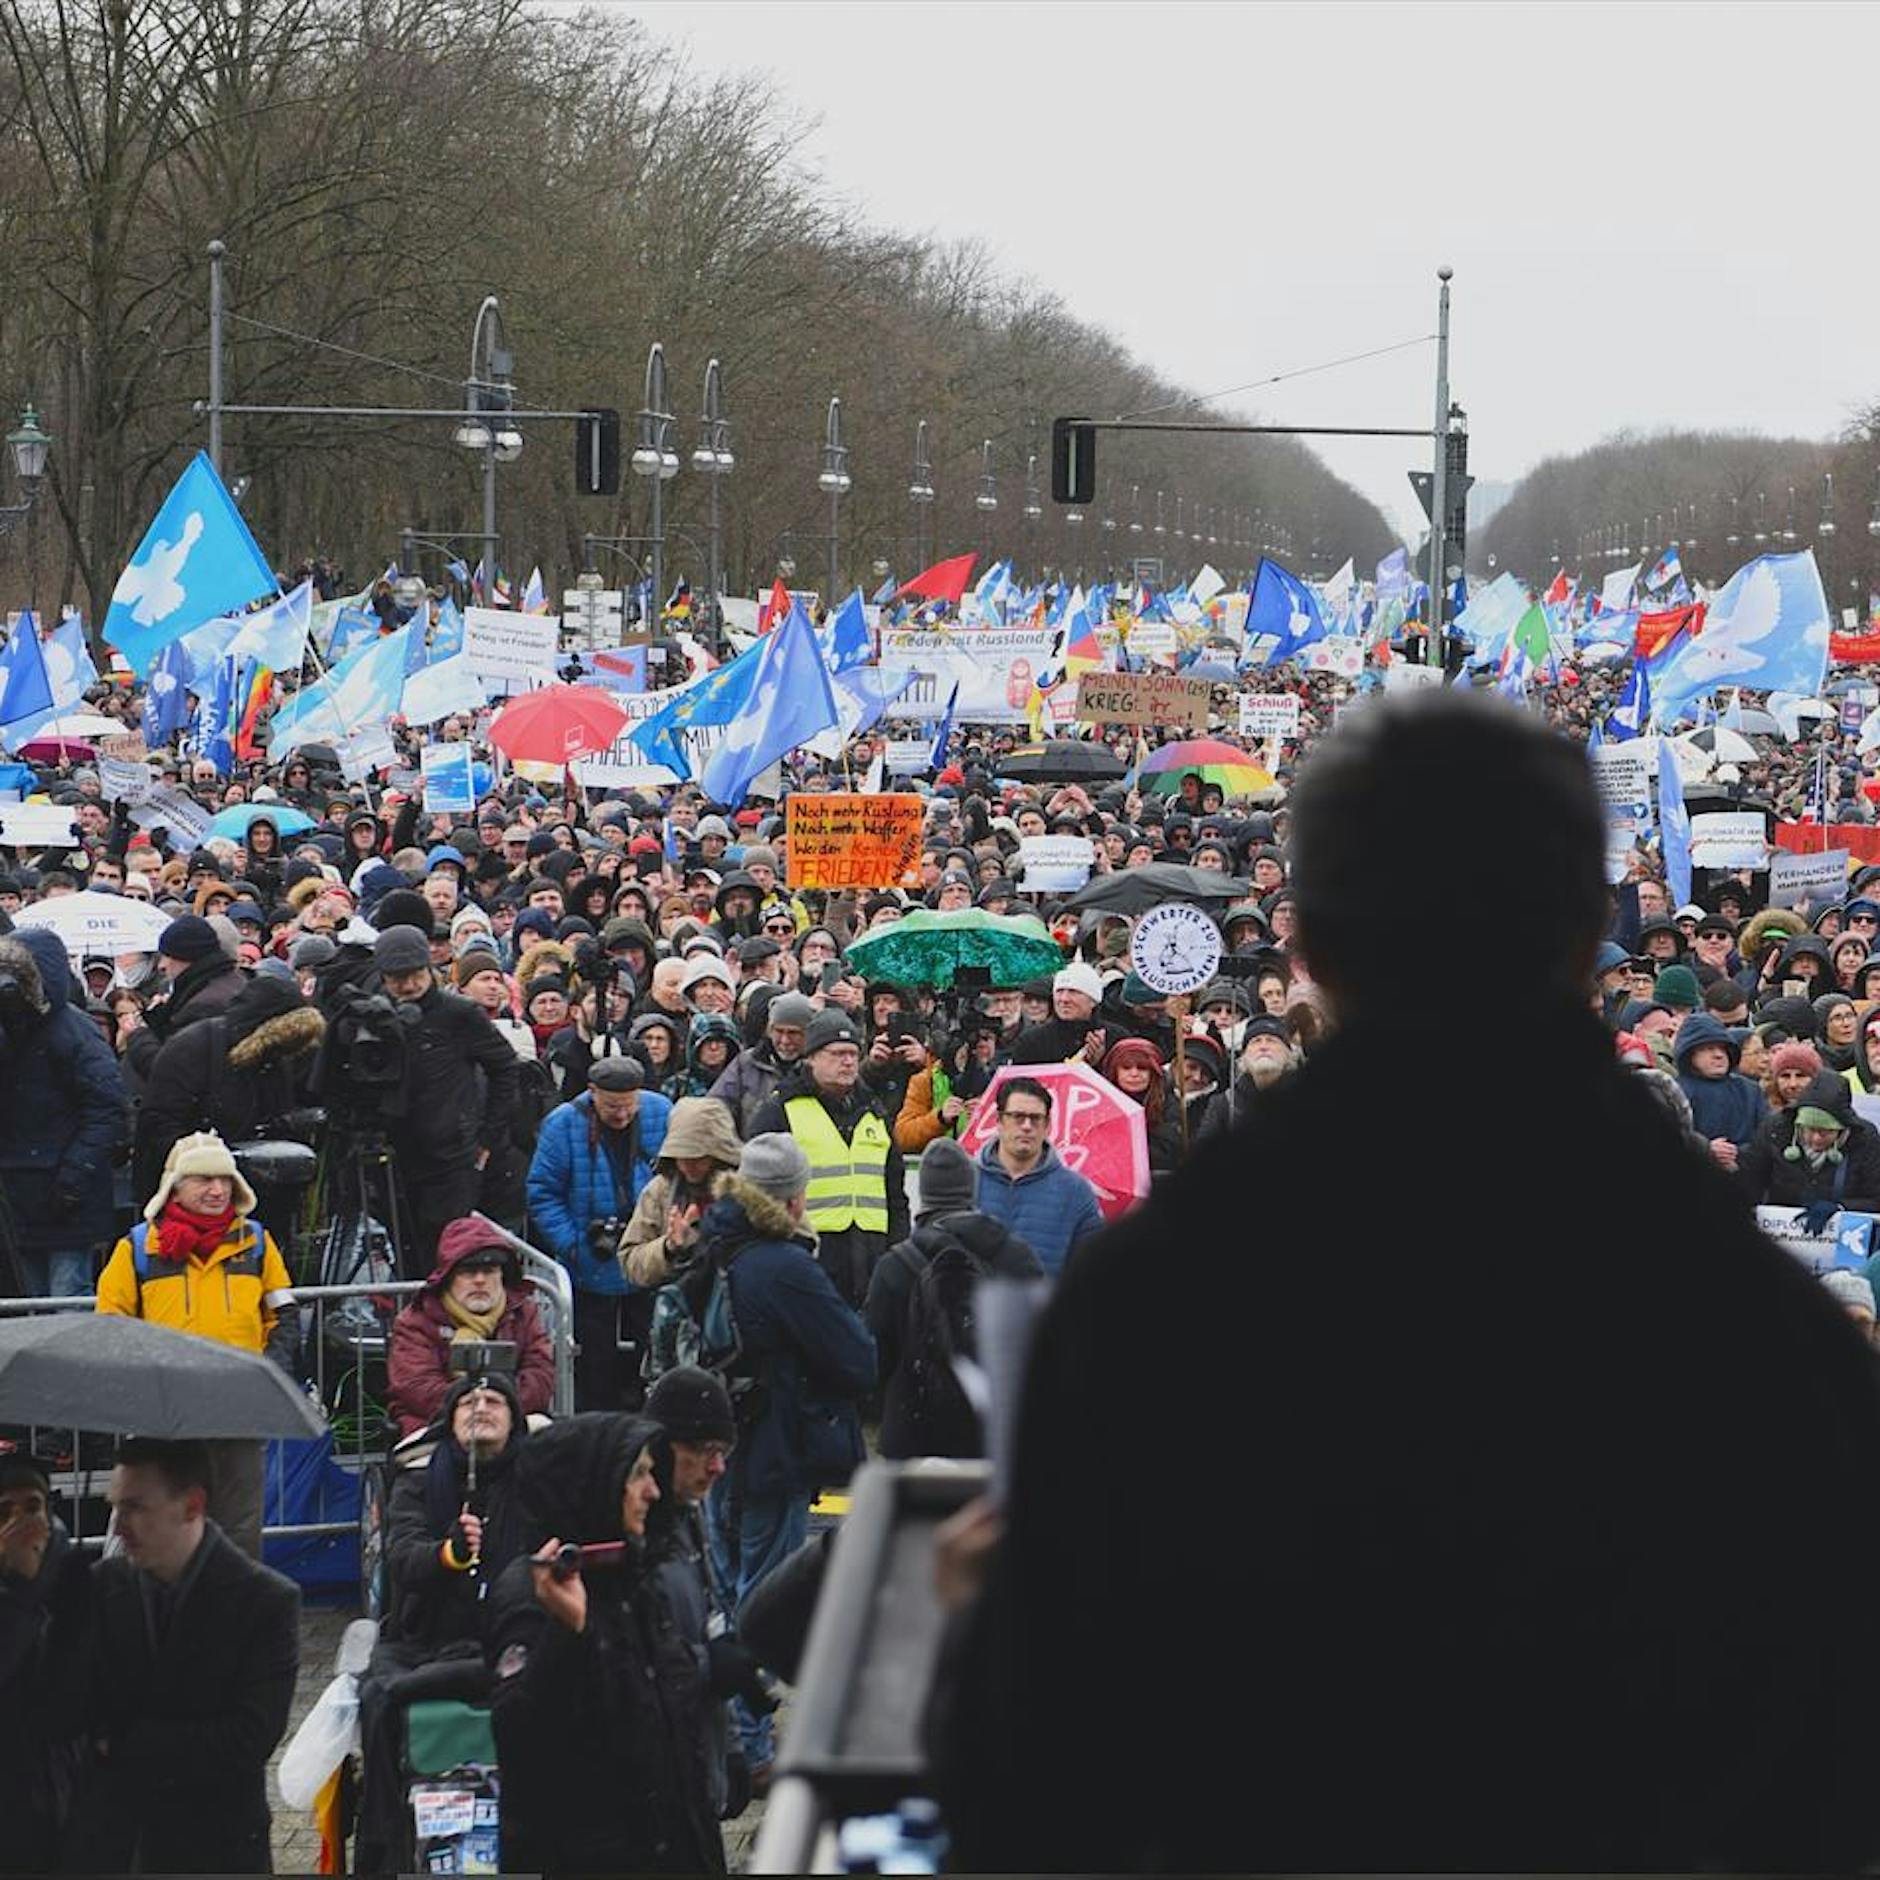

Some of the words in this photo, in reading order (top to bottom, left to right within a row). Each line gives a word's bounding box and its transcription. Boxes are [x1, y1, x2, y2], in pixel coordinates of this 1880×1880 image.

[976, 633, 1045, 648] Russland
[1082, 674, 1138, 691] MEINEN
[796, 802, 829, 818] Noch
[794, 820, 829, 836] Noch
[795, 859, 889, 885] FRIEDEN
[86, 919, 120, 929] DIE
